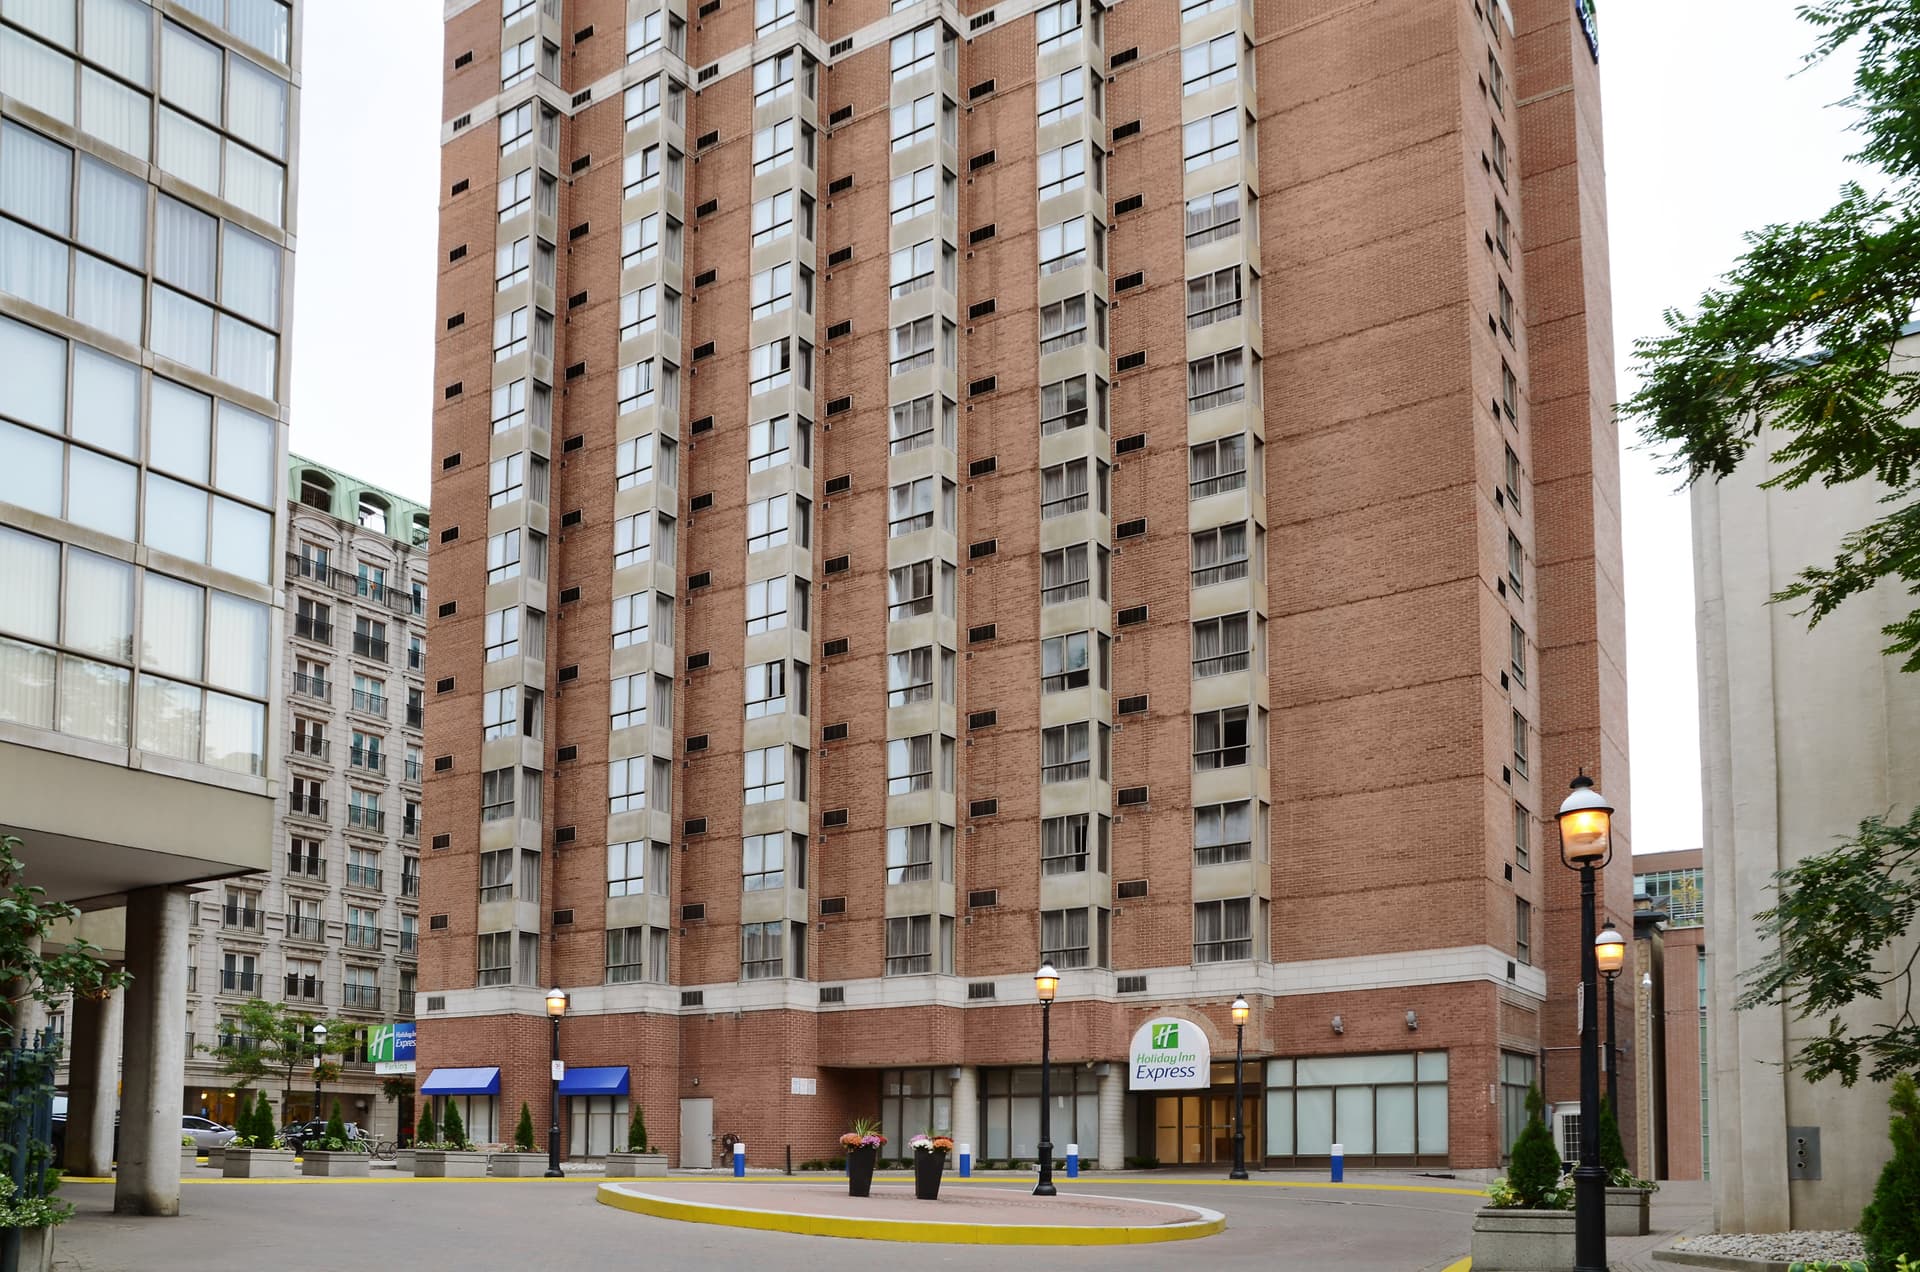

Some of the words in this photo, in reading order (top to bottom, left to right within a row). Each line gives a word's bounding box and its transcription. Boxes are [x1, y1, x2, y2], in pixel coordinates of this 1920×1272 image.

[396, 1039, 416, 1048] Expres
[1136, 1052, 1177, 1065] Holiday
[1178, 1051, 1196, 1062] Inn
[1136, 1064, 1196, 1082] Express
